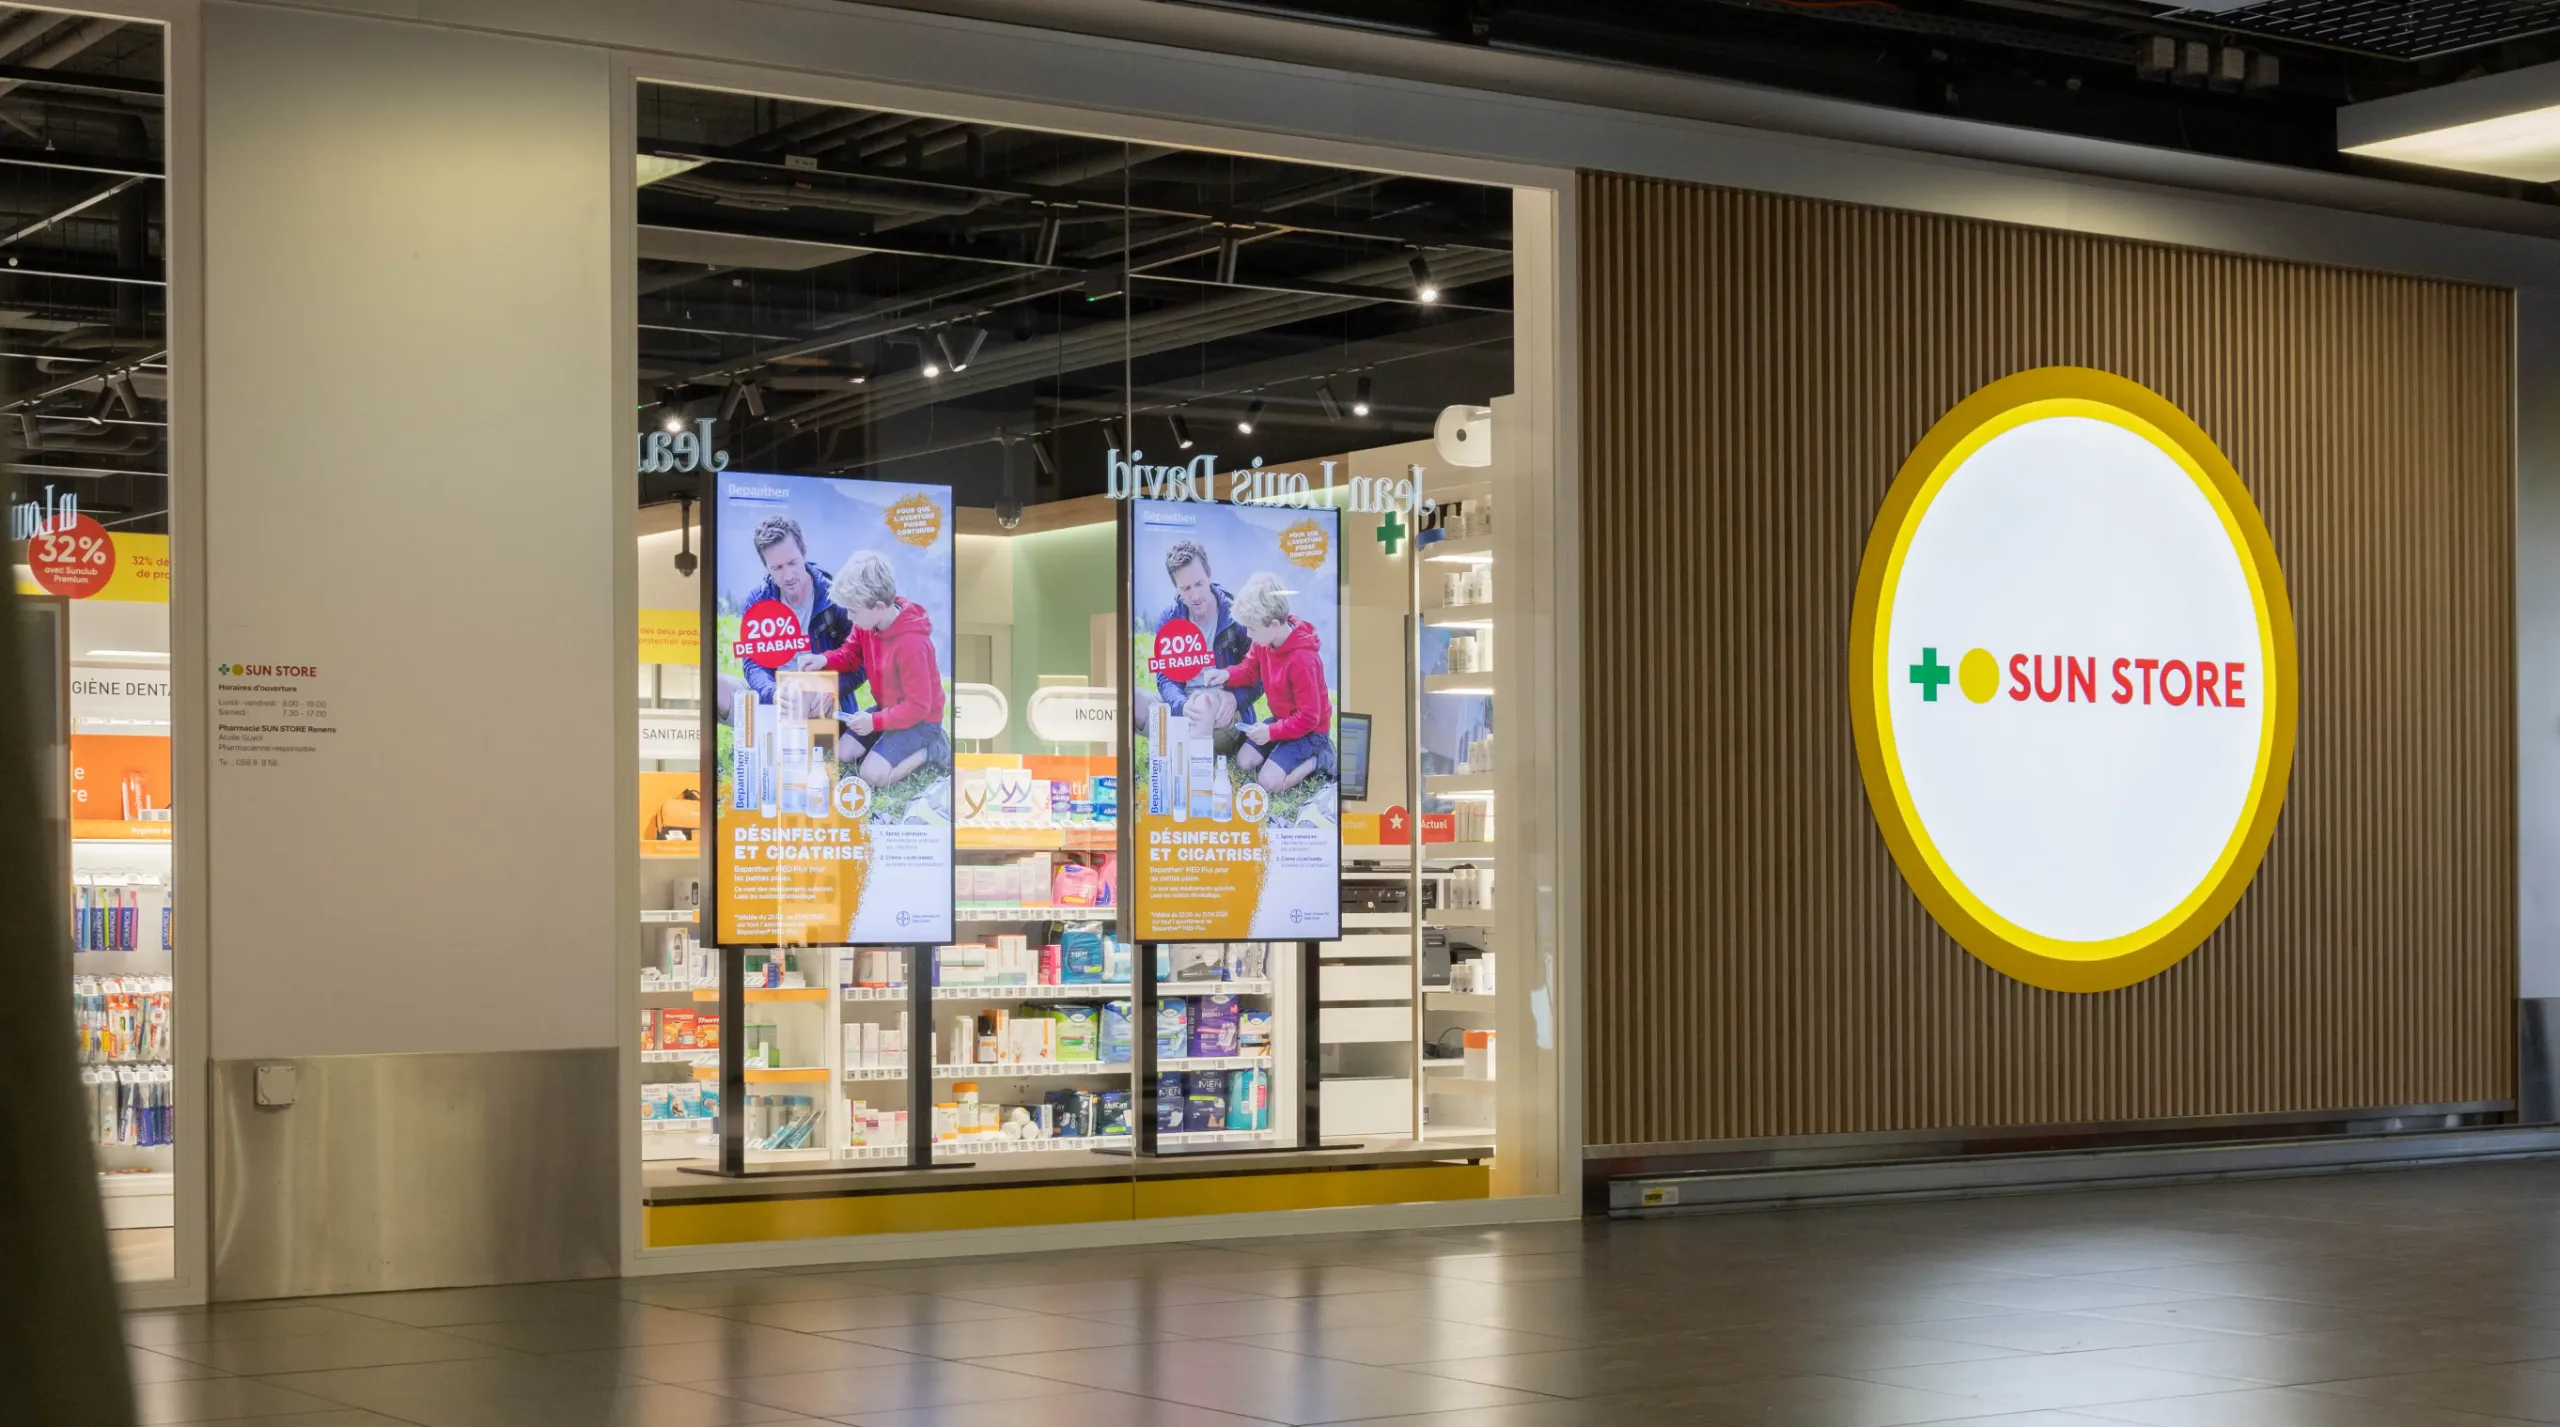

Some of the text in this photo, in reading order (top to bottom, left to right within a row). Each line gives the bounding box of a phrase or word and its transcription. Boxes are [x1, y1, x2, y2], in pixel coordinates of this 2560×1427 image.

[729, 484, 789, 498] Bepanthen
[1143, 510, 1196, 524] Bepanthen
[896, 527, 935, 536] CONTINUER
[38, 534, 106, 565] 32%
[132, 556, 152, 566] 32%
[44, 567, 98, 576] avec Sunclub
[137, 569, 149, 579] de
[54, 575, 89, 584] Premium
[747, 616, 796, 640] 20%
[735, 642, 754, 655] DE
[1160, 634, 1202, 655] 20%
[246, 665, 317, 677] SUN STORE
[1150, 659, 1167, 671] DE
[2008, 653, 2246, 708] SUN STORE
[126, 682, 171, 697] DENT
[219, 684, 297, 693] Horaires d'ouverture
[1075, 708, 1117, 721] INCON
[219, 744, 271, 752] Pharmacienne
[736, 749, 746, 809] Bepanthen
[1151, 760, 1160, 814] Bepanthen
[1421, 819, 1447, 829] Actuel
[734, 824, 851, 842] DÉSINFECTE
[1149, 827, 1251, 845] DÉSINFECTE
[734, 845, 759, 859] ET
[1149, 847, 1171, 861] ET
[1199, 1080, 1221, 1088] MEN
[1159, 1088, 1180, 1096] MEN
